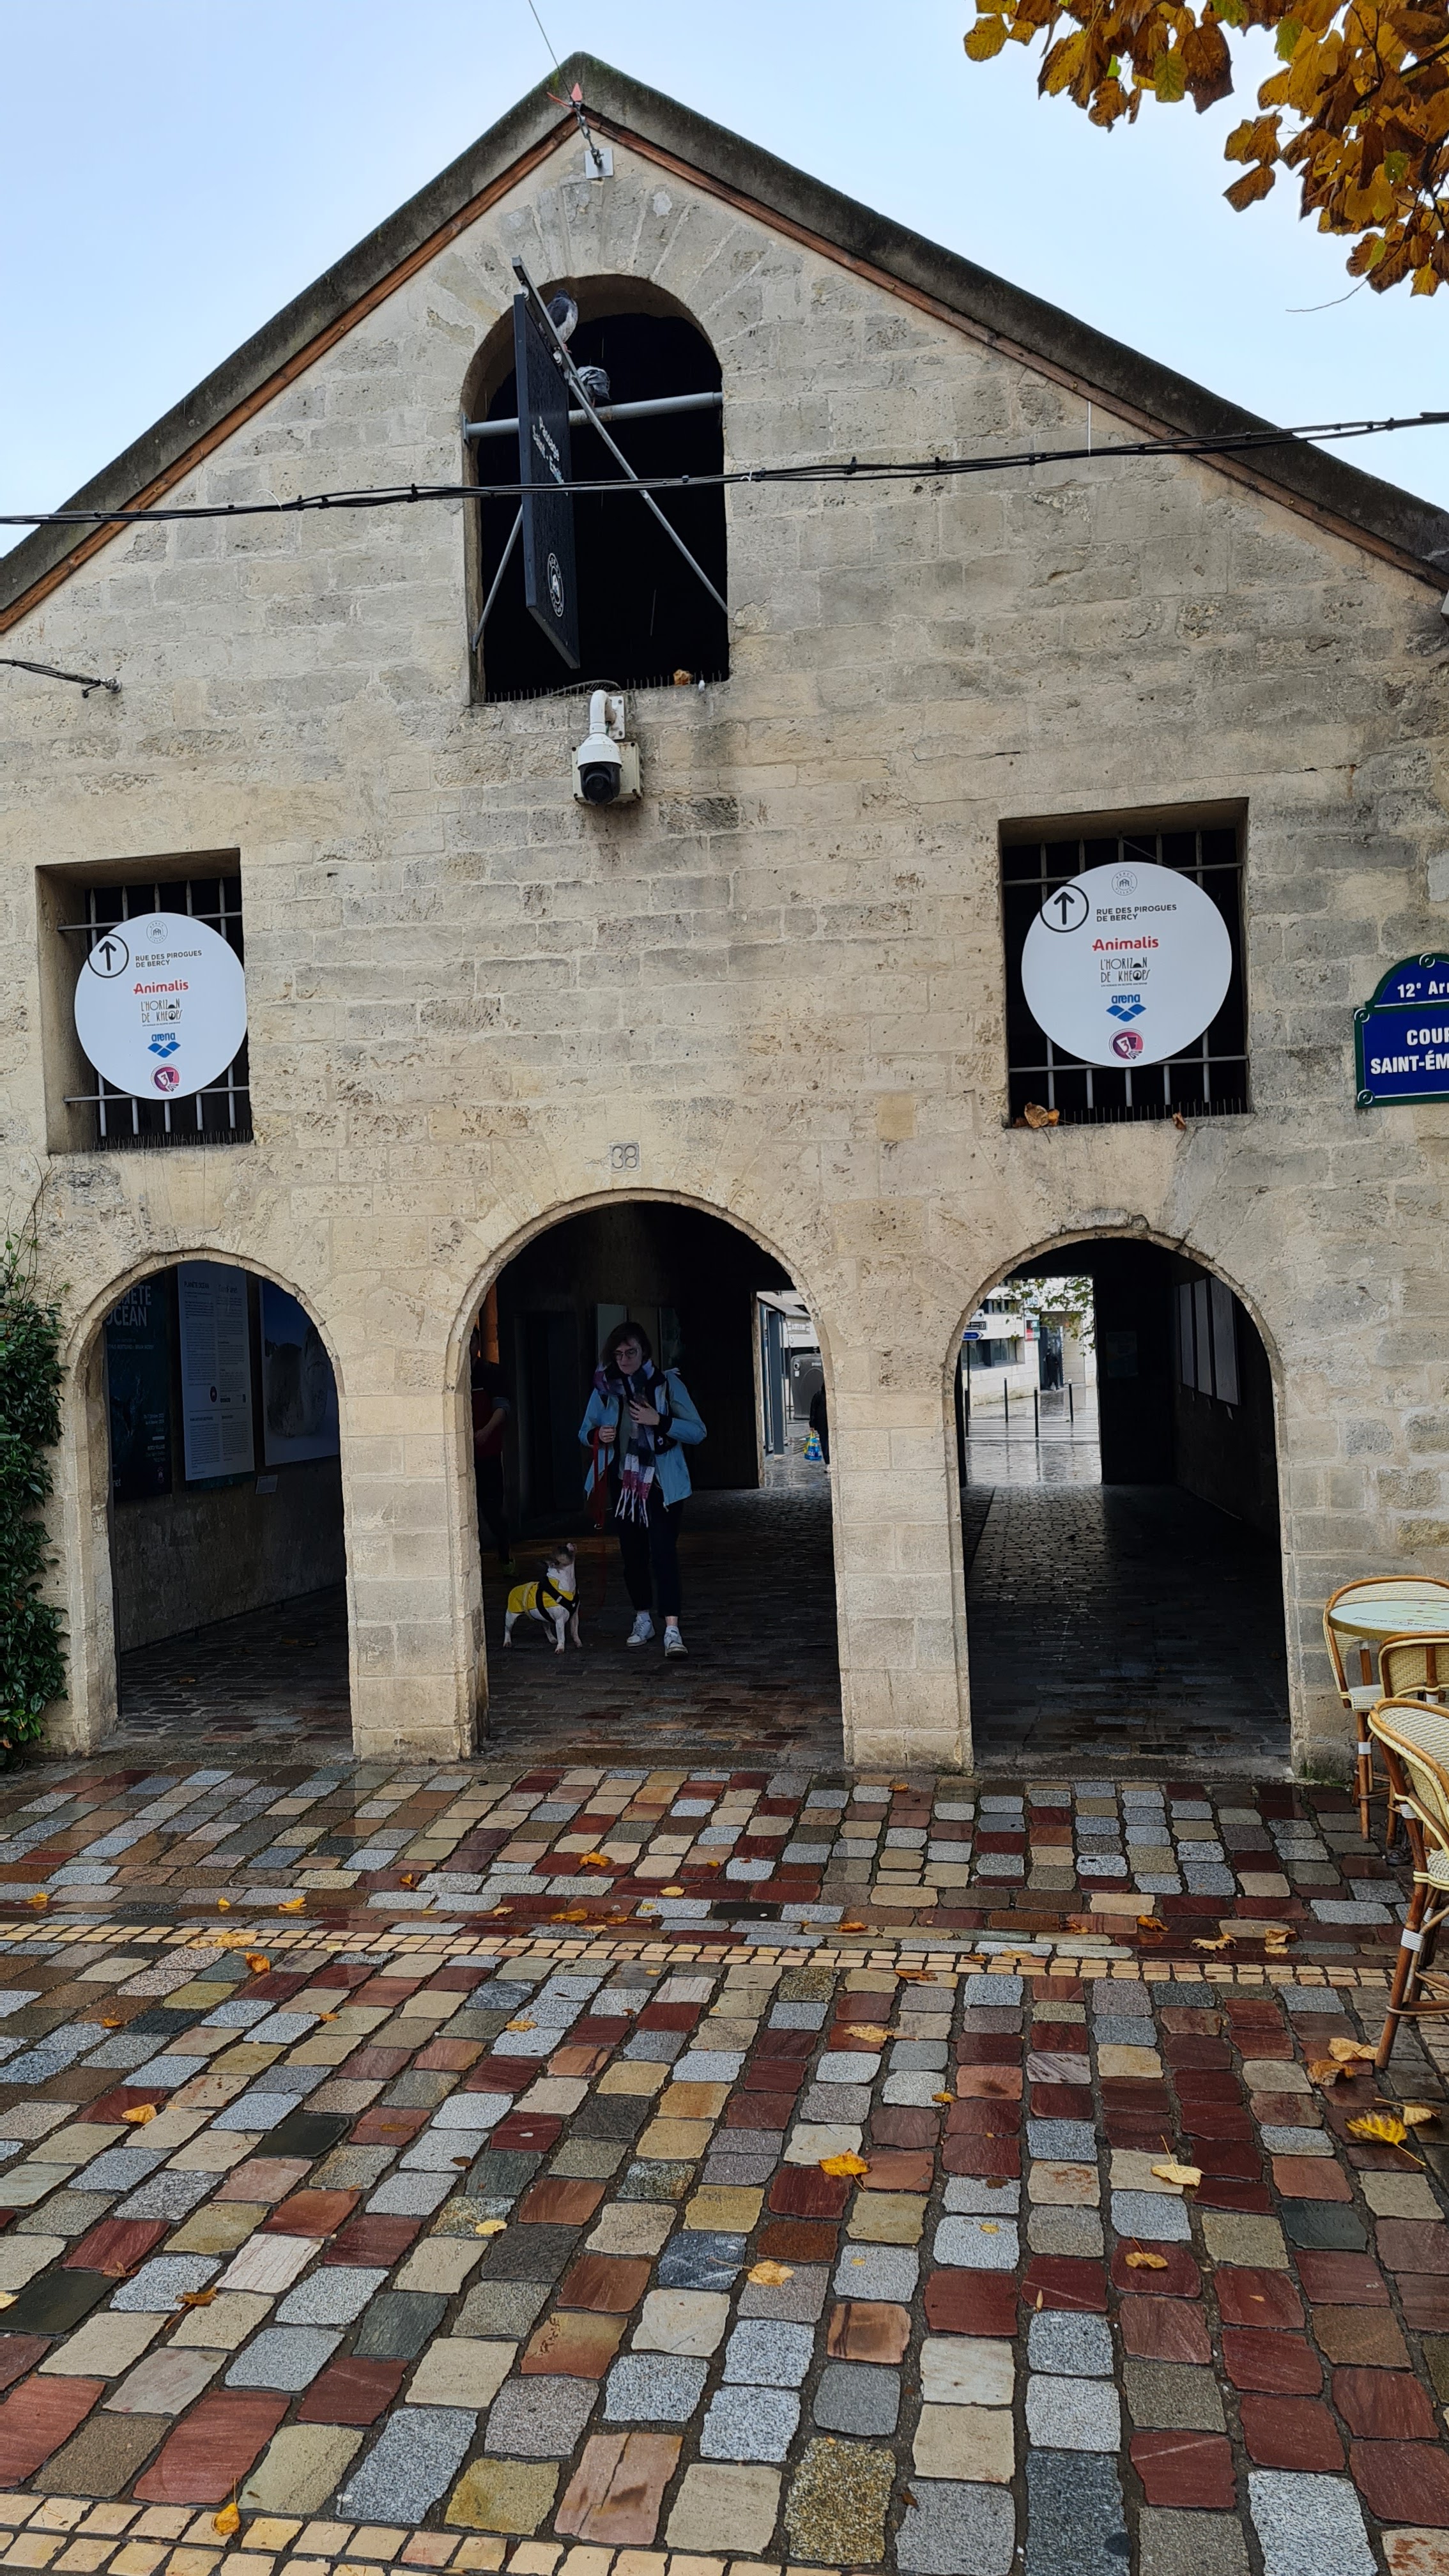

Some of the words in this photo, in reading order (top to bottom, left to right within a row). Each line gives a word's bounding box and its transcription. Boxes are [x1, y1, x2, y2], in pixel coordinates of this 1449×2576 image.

[1135, 904, 1177, 912] PIROGUES
[1092, 935, 1159, 951] Animalis
[167, 950, 202, 959] PIROGUES
[147, 959, 171, 967] BERCY
[1101, 971, 1111, 983] DE
[1118, 969, 1151, 982] KHEOPS
[133, 979, 189, 995] Animalis
[1111, 993, 1140, 1004] arena
[141, 1012, 150, 1023] DE
[151, 1032, 176, 1042] arena
[1370, 1050, 1449, 1075] SAINT-ÉM
[612, 1145, 638, 1169] 38
